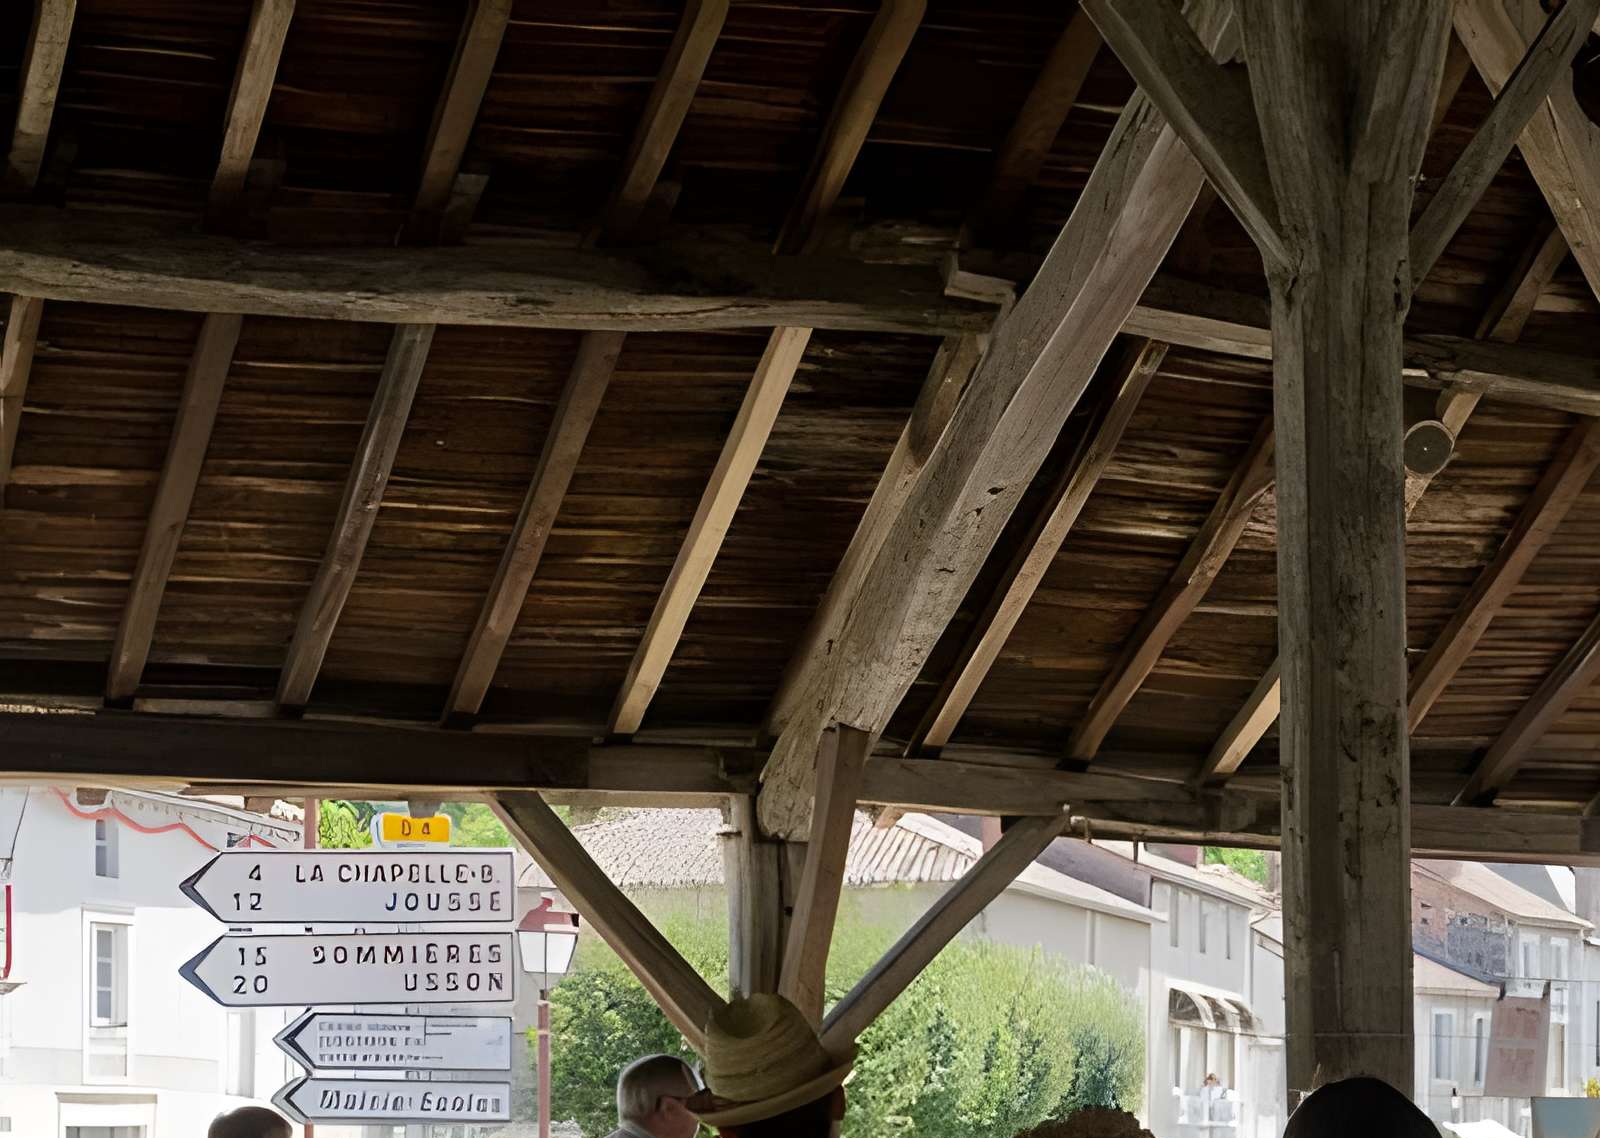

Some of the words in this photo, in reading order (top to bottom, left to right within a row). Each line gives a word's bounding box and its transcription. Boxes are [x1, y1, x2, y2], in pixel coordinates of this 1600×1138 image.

[401, 819, 412, 837] D
[248, 864, 262, 881] 4
[295, 864, 324, 883] LA
[233, 892, 262, 911] 12
[238, 946, 267, 966] 15
[232, 974, 268, 994] 20
[404, 972, 503, 992] USSON
